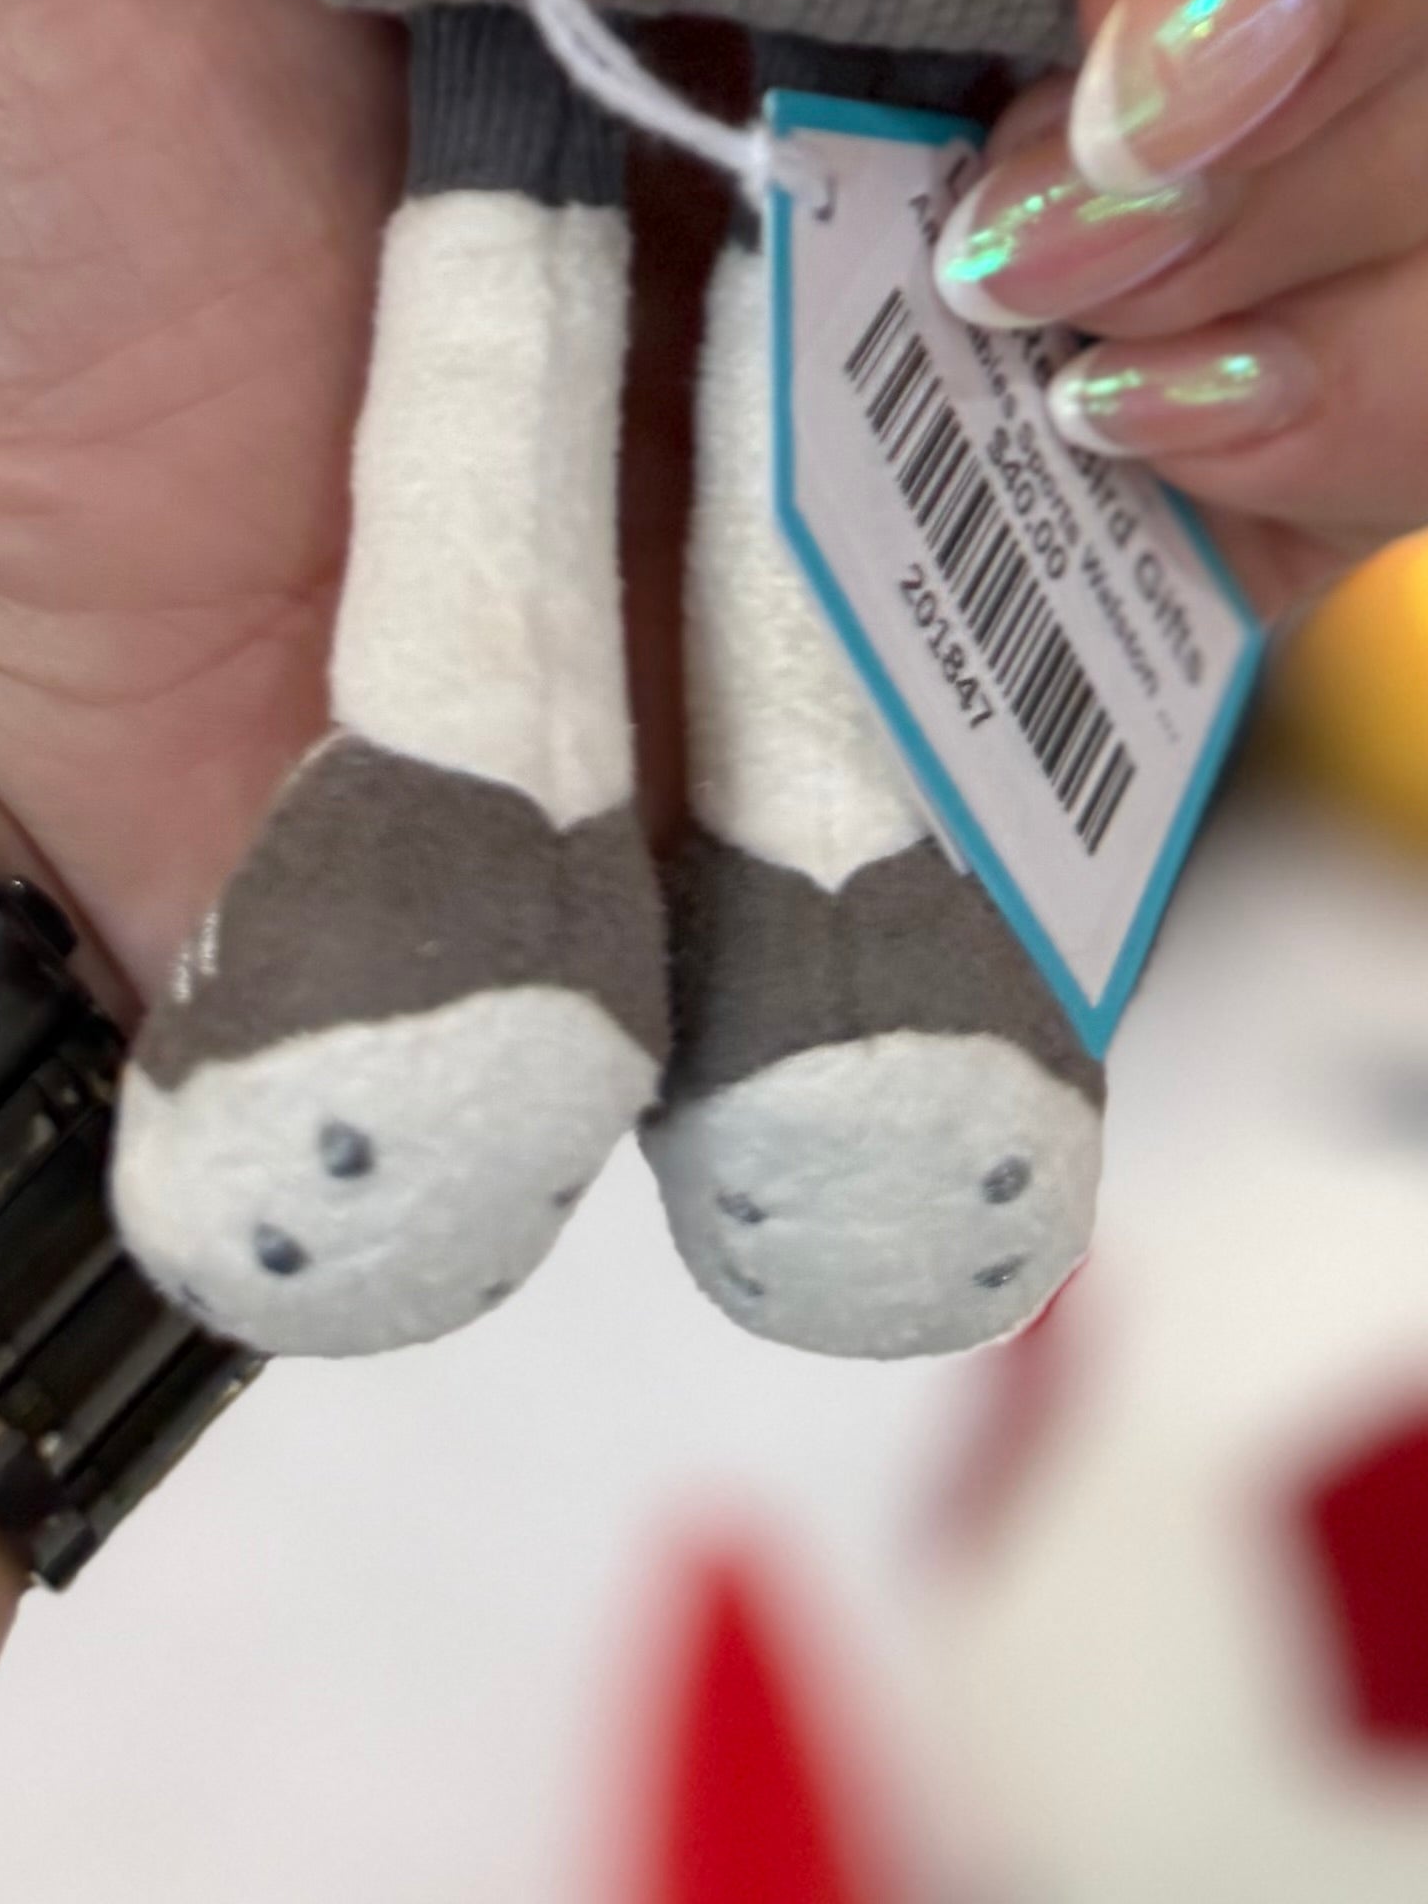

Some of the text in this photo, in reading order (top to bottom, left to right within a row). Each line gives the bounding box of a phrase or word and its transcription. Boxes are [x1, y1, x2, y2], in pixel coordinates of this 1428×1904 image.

[985, 424, 1067, 580] $40.00
[1017, 420, 1080, 549] Sports
[898, 561, 996, 730] 201847
[1132, 549, 1206, 688] Gifts
